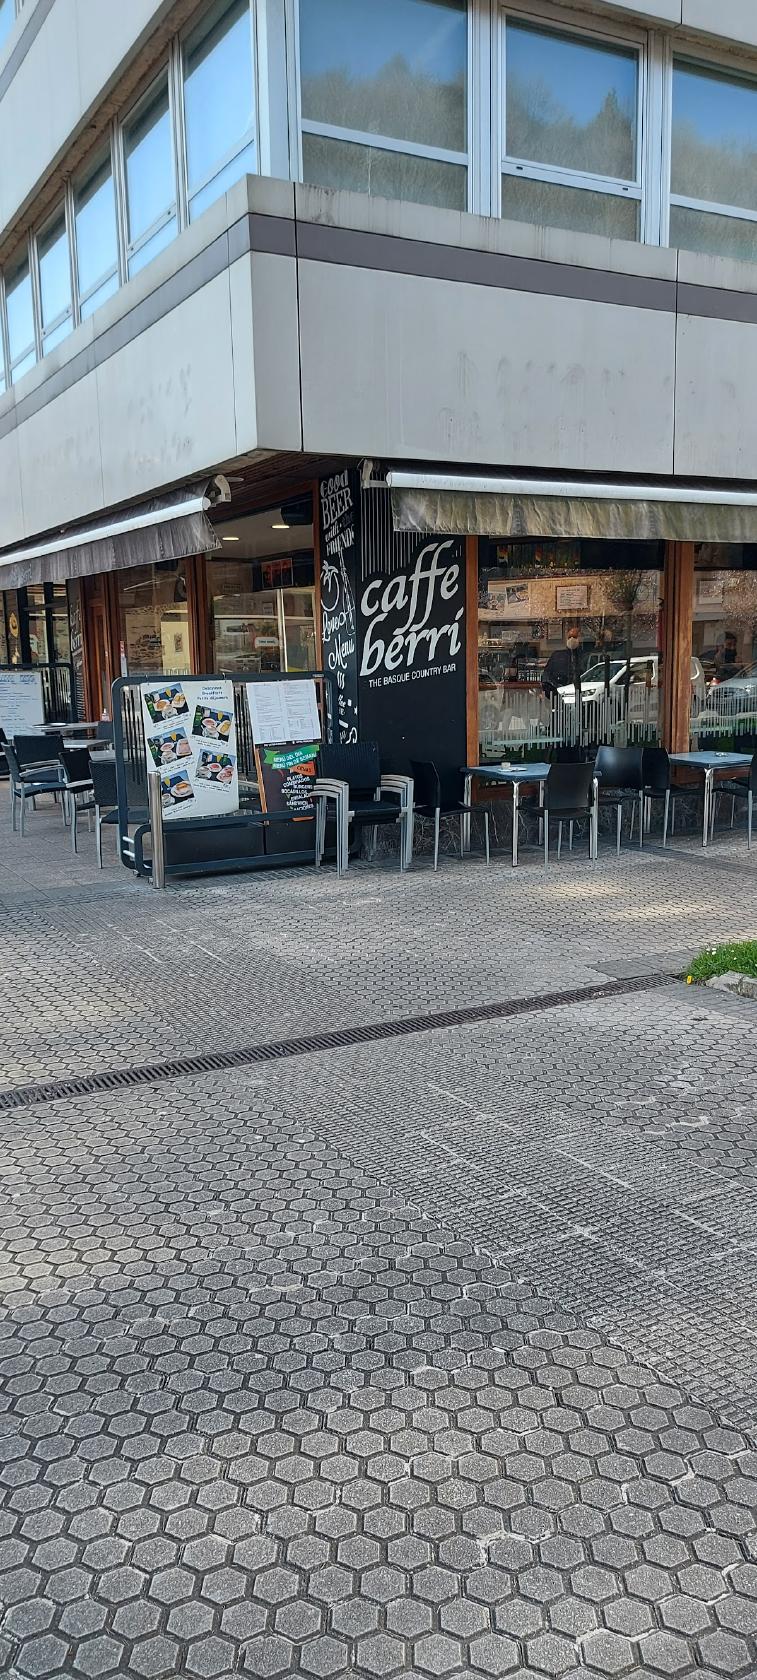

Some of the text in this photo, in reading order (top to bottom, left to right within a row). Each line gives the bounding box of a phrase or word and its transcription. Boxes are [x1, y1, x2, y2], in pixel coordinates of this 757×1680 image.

[321, 487, 353, 530] BEER
[325, 521, 340, 542] with
[361, 540, 460, 636] caffe
[328, 633, 355, 670] Menu
[360, 607, 464, 677] berri
[369, 662, 456, 688] THE BASQUE COUNTRY BAR
